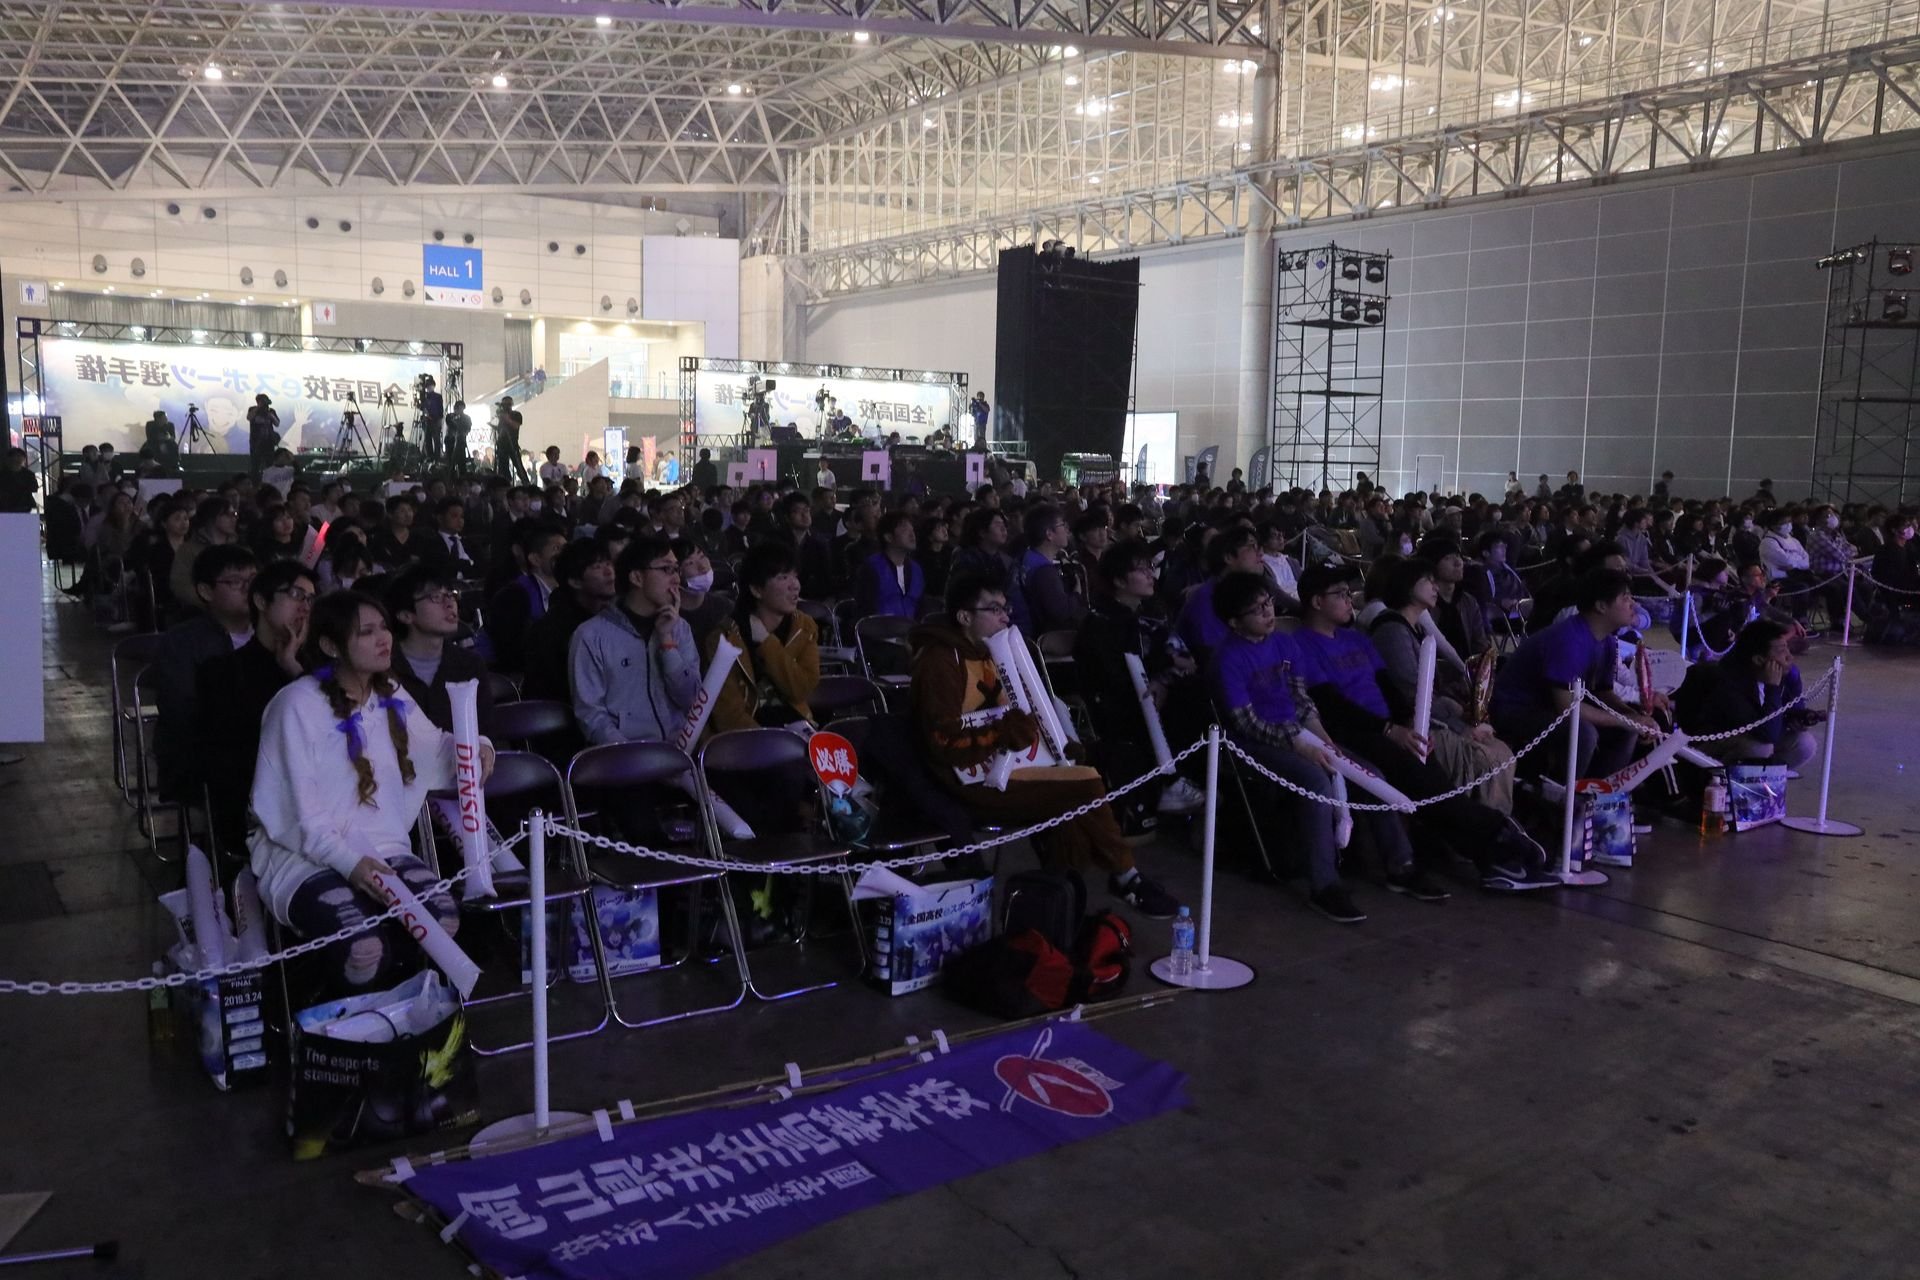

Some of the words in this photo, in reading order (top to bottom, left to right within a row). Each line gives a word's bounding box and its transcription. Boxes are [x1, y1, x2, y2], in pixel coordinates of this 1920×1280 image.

[429, 264, 460, 278] HALL
[464, 258, 473, 279] 1
[675, 687, 709, 750] DENSO
[815, 746, 855, 777] 必勝
[1611, 756, 1649, 793] DENS
[454, 742, 482, 834] DENSO
[224, 991, 263, 1007] 2019.3.24
[304, 1047, 327, 1064] The
[330, 1055, 380, 1072] esports
[303, 1068, 360, 1087] standard
